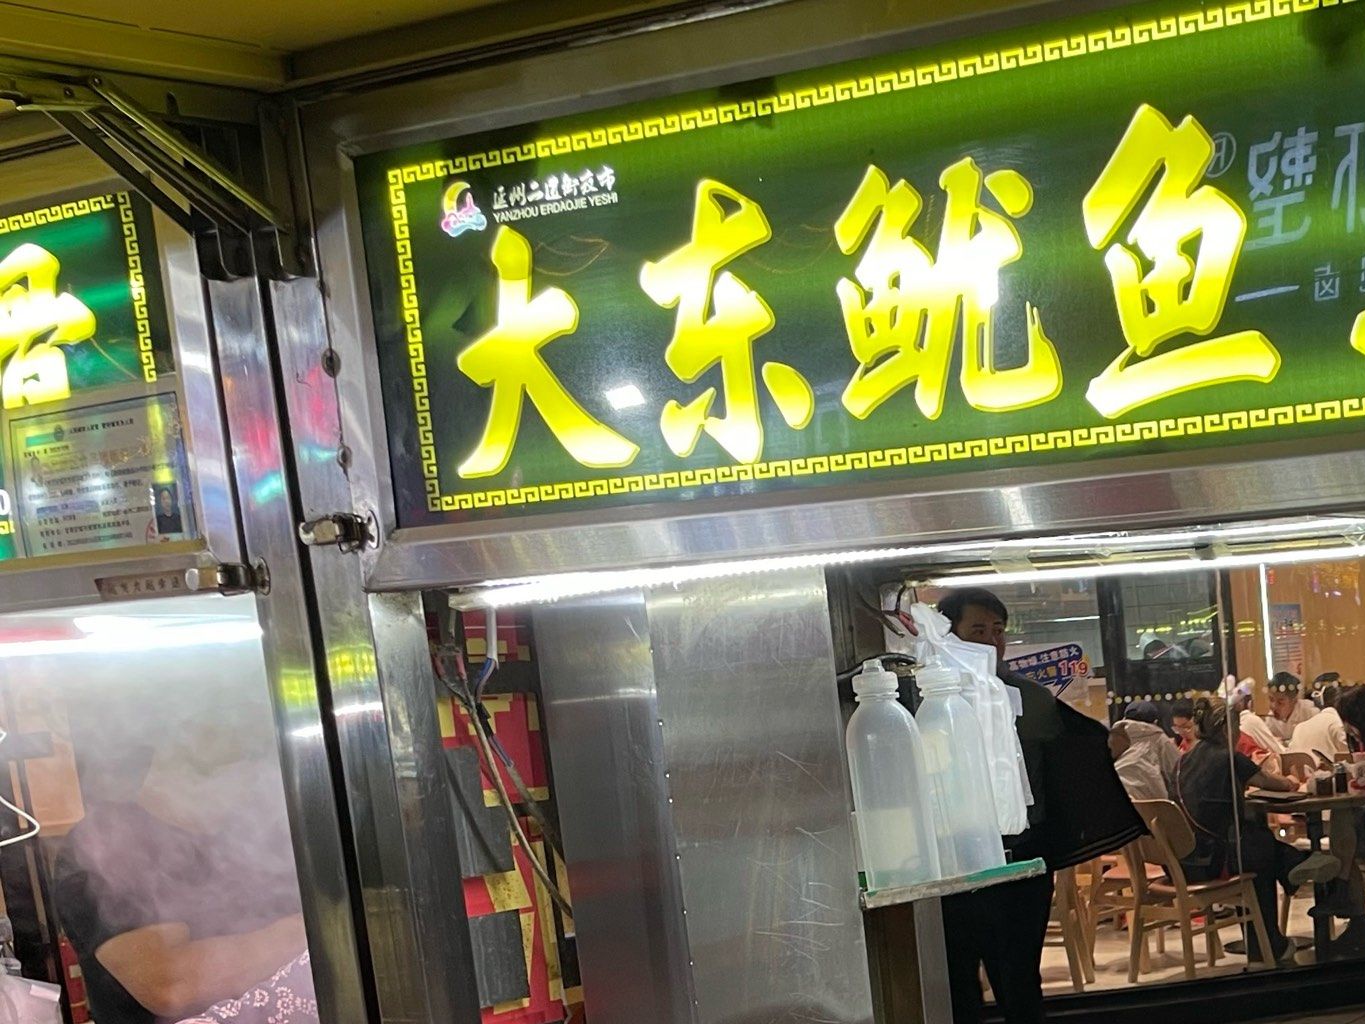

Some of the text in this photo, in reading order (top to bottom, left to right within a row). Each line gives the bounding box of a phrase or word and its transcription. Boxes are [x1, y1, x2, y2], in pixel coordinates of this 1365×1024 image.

[493, 165, 617, 210] 延州二道街夜市
[493, 191, 619, 224] YANZHOU ERDAOJIE YESHI
